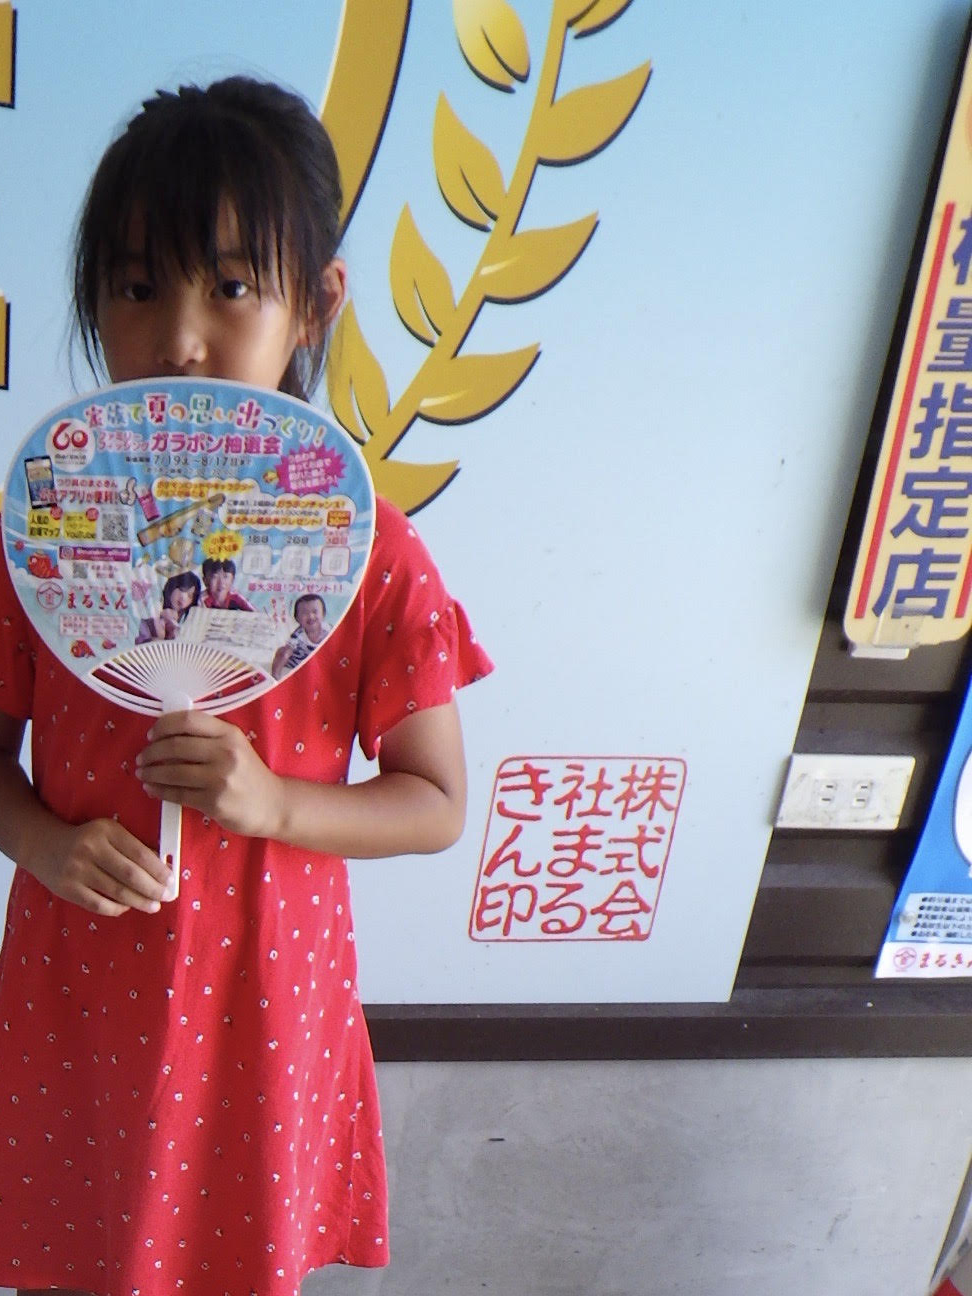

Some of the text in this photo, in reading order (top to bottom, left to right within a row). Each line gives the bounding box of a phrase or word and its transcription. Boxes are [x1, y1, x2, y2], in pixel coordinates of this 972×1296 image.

[871, 212, 972, 620] 量指定店
[150, 432, 281, 455] ガラポン抽選会
[67, 591, 129, 610] まるきん
[919, 952, 972, 969] まるき
